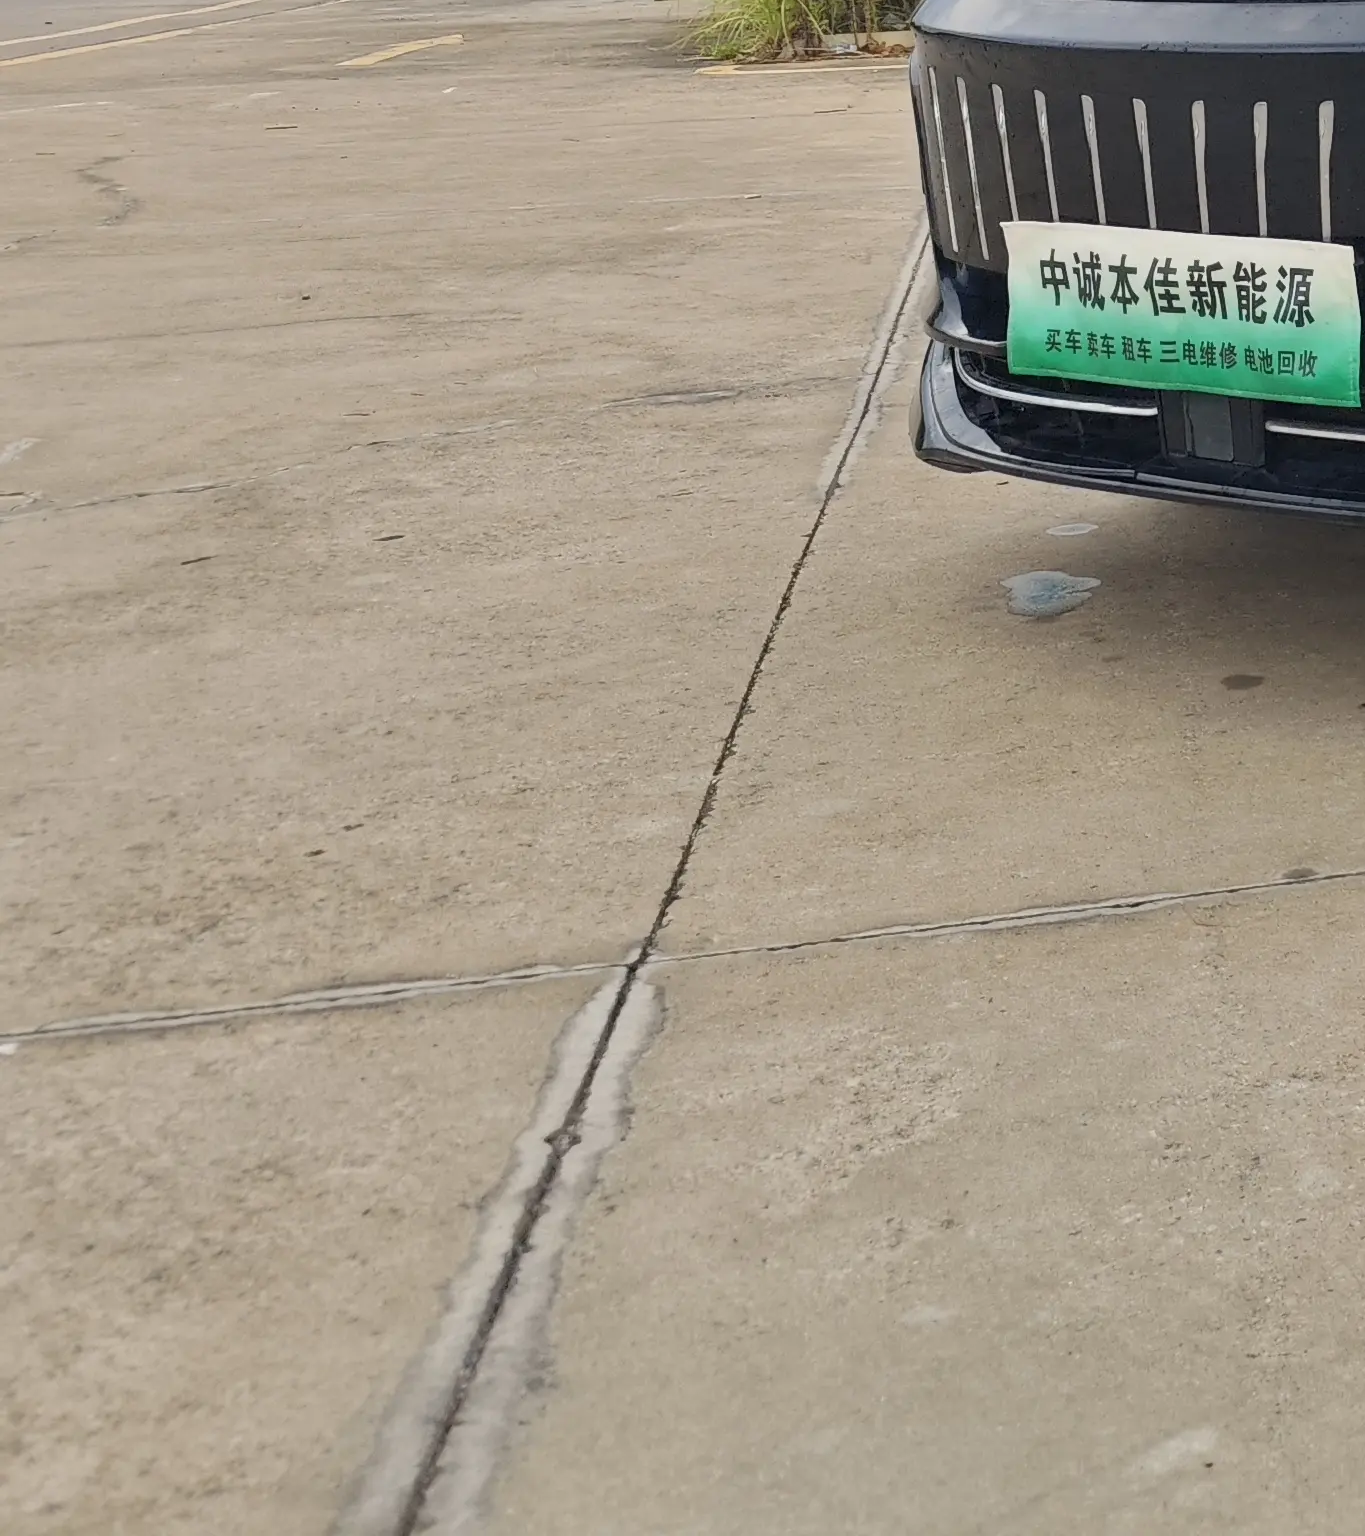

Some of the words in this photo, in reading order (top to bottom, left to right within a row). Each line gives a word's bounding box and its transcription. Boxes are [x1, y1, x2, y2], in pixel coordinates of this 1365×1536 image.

[1039, 248, 1316, 328] 中诚本佳新能源
[1045, 328, 1082, 354] 买车
[1087, 331, 1116, 359] 卖车
[1121, 335, 1152, 364] 租车
[1159, 339, 1238, 369] 三电维修
[1244, 348, 1318, 378] 电池回收
